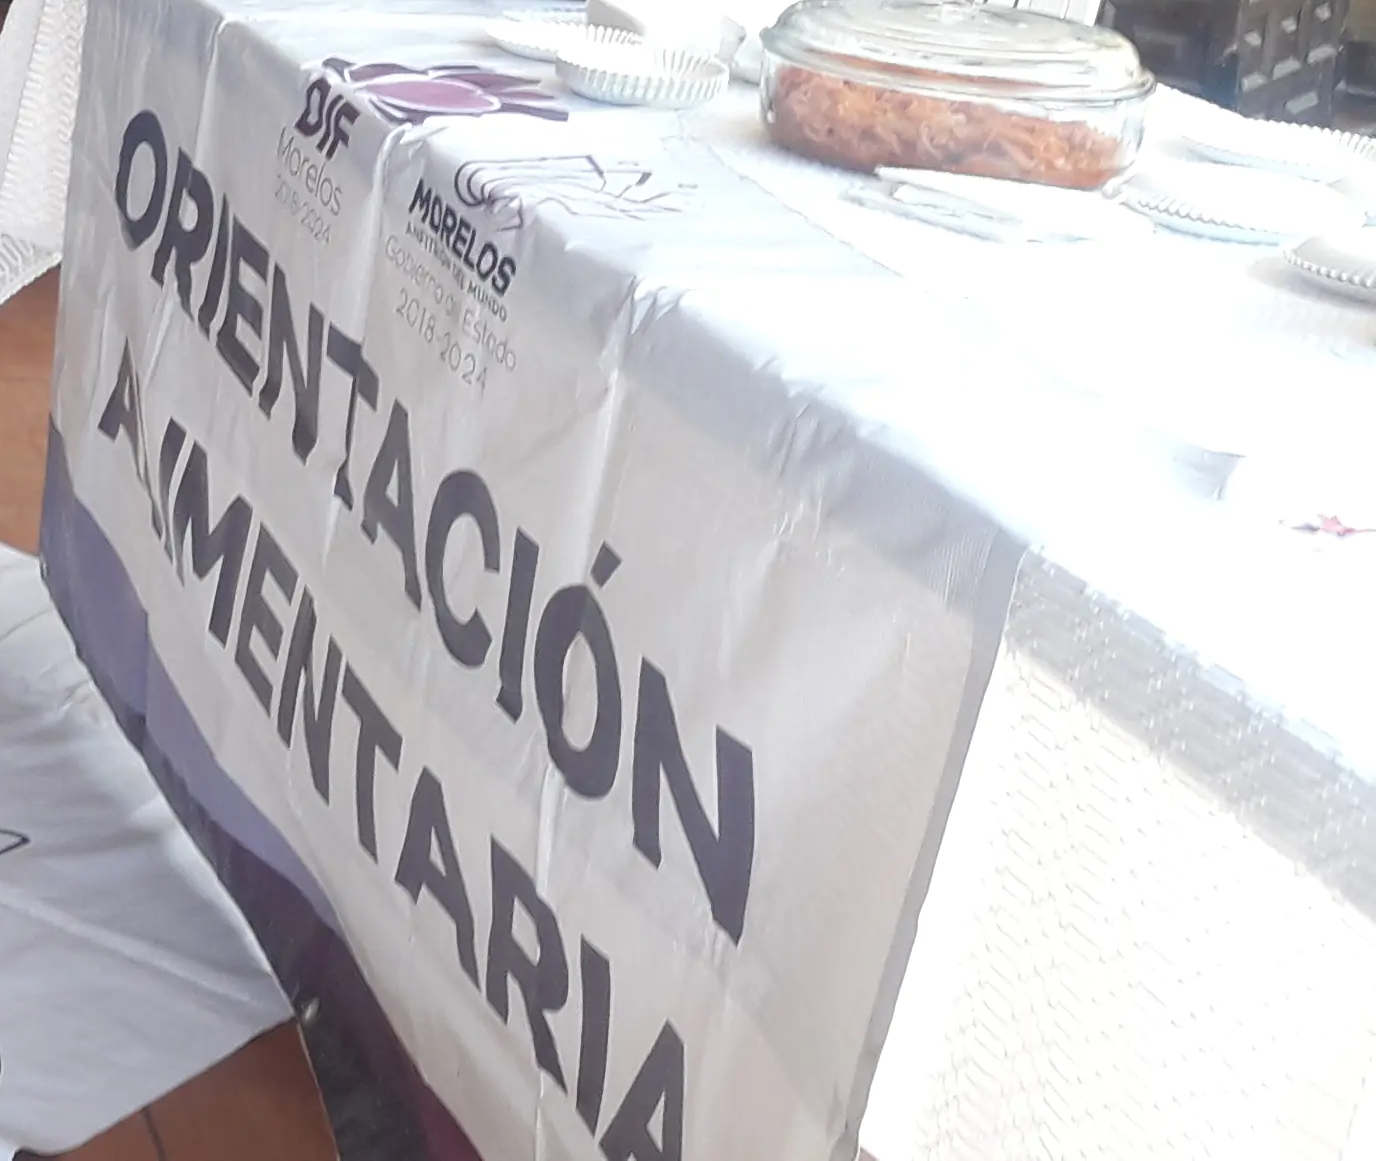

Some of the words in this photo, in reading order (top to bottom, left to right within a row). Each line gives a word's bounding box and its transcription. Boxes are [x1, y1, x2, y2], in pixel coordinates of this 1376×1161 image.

[277, 126, 344, 217] Morelos
[295, 77, 361, 161] DIF
[408, 178, 517, 297] MORELOS
[115, 110, 756, 945] ORIENTACIÓN
[98, 336, 686, 1161] AIMENTARIA
